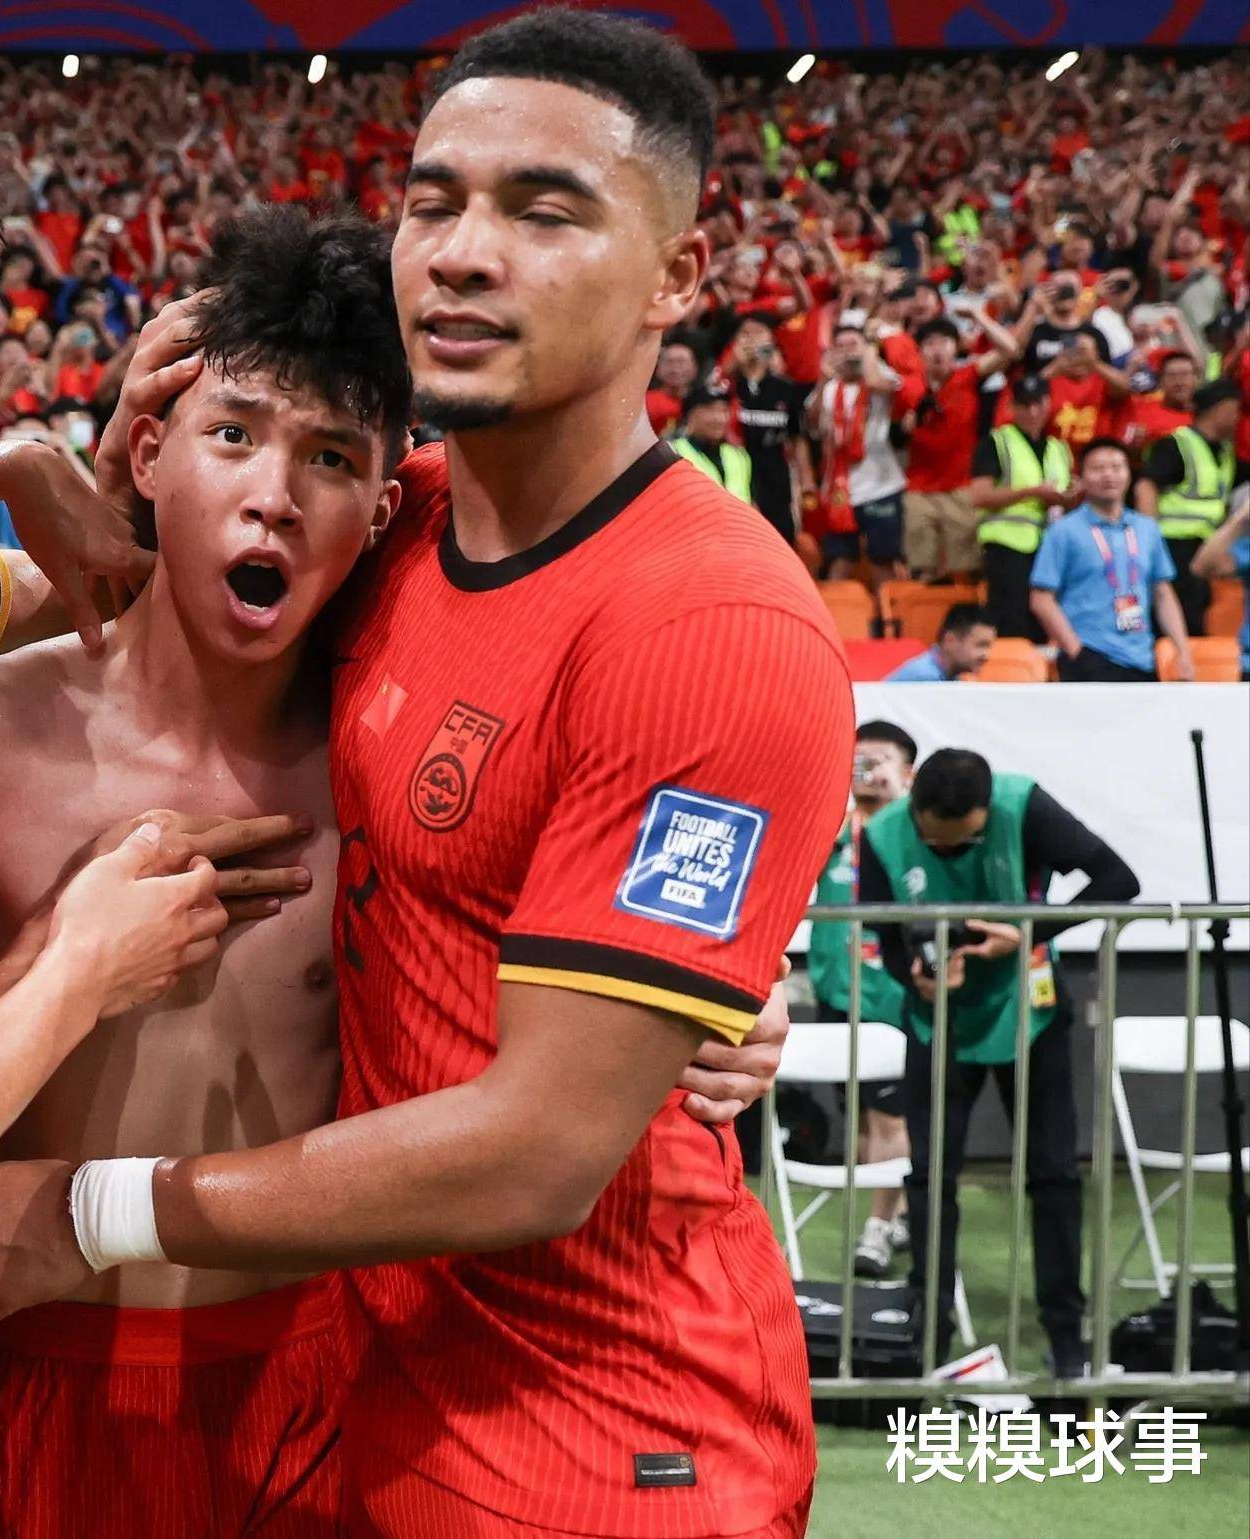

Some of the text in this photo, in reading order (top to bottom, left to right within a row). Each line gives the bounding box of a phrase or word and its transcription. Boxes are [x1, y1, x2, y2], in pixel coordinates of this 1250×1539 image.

[445, 709, 493, 746] CFA
[670, 810, 738, 844] FOOTBALL
[662, 828, 734, 868] UNITES
[678, 857, 732, 892] World
[668, 886, 697, 901] FIFA
